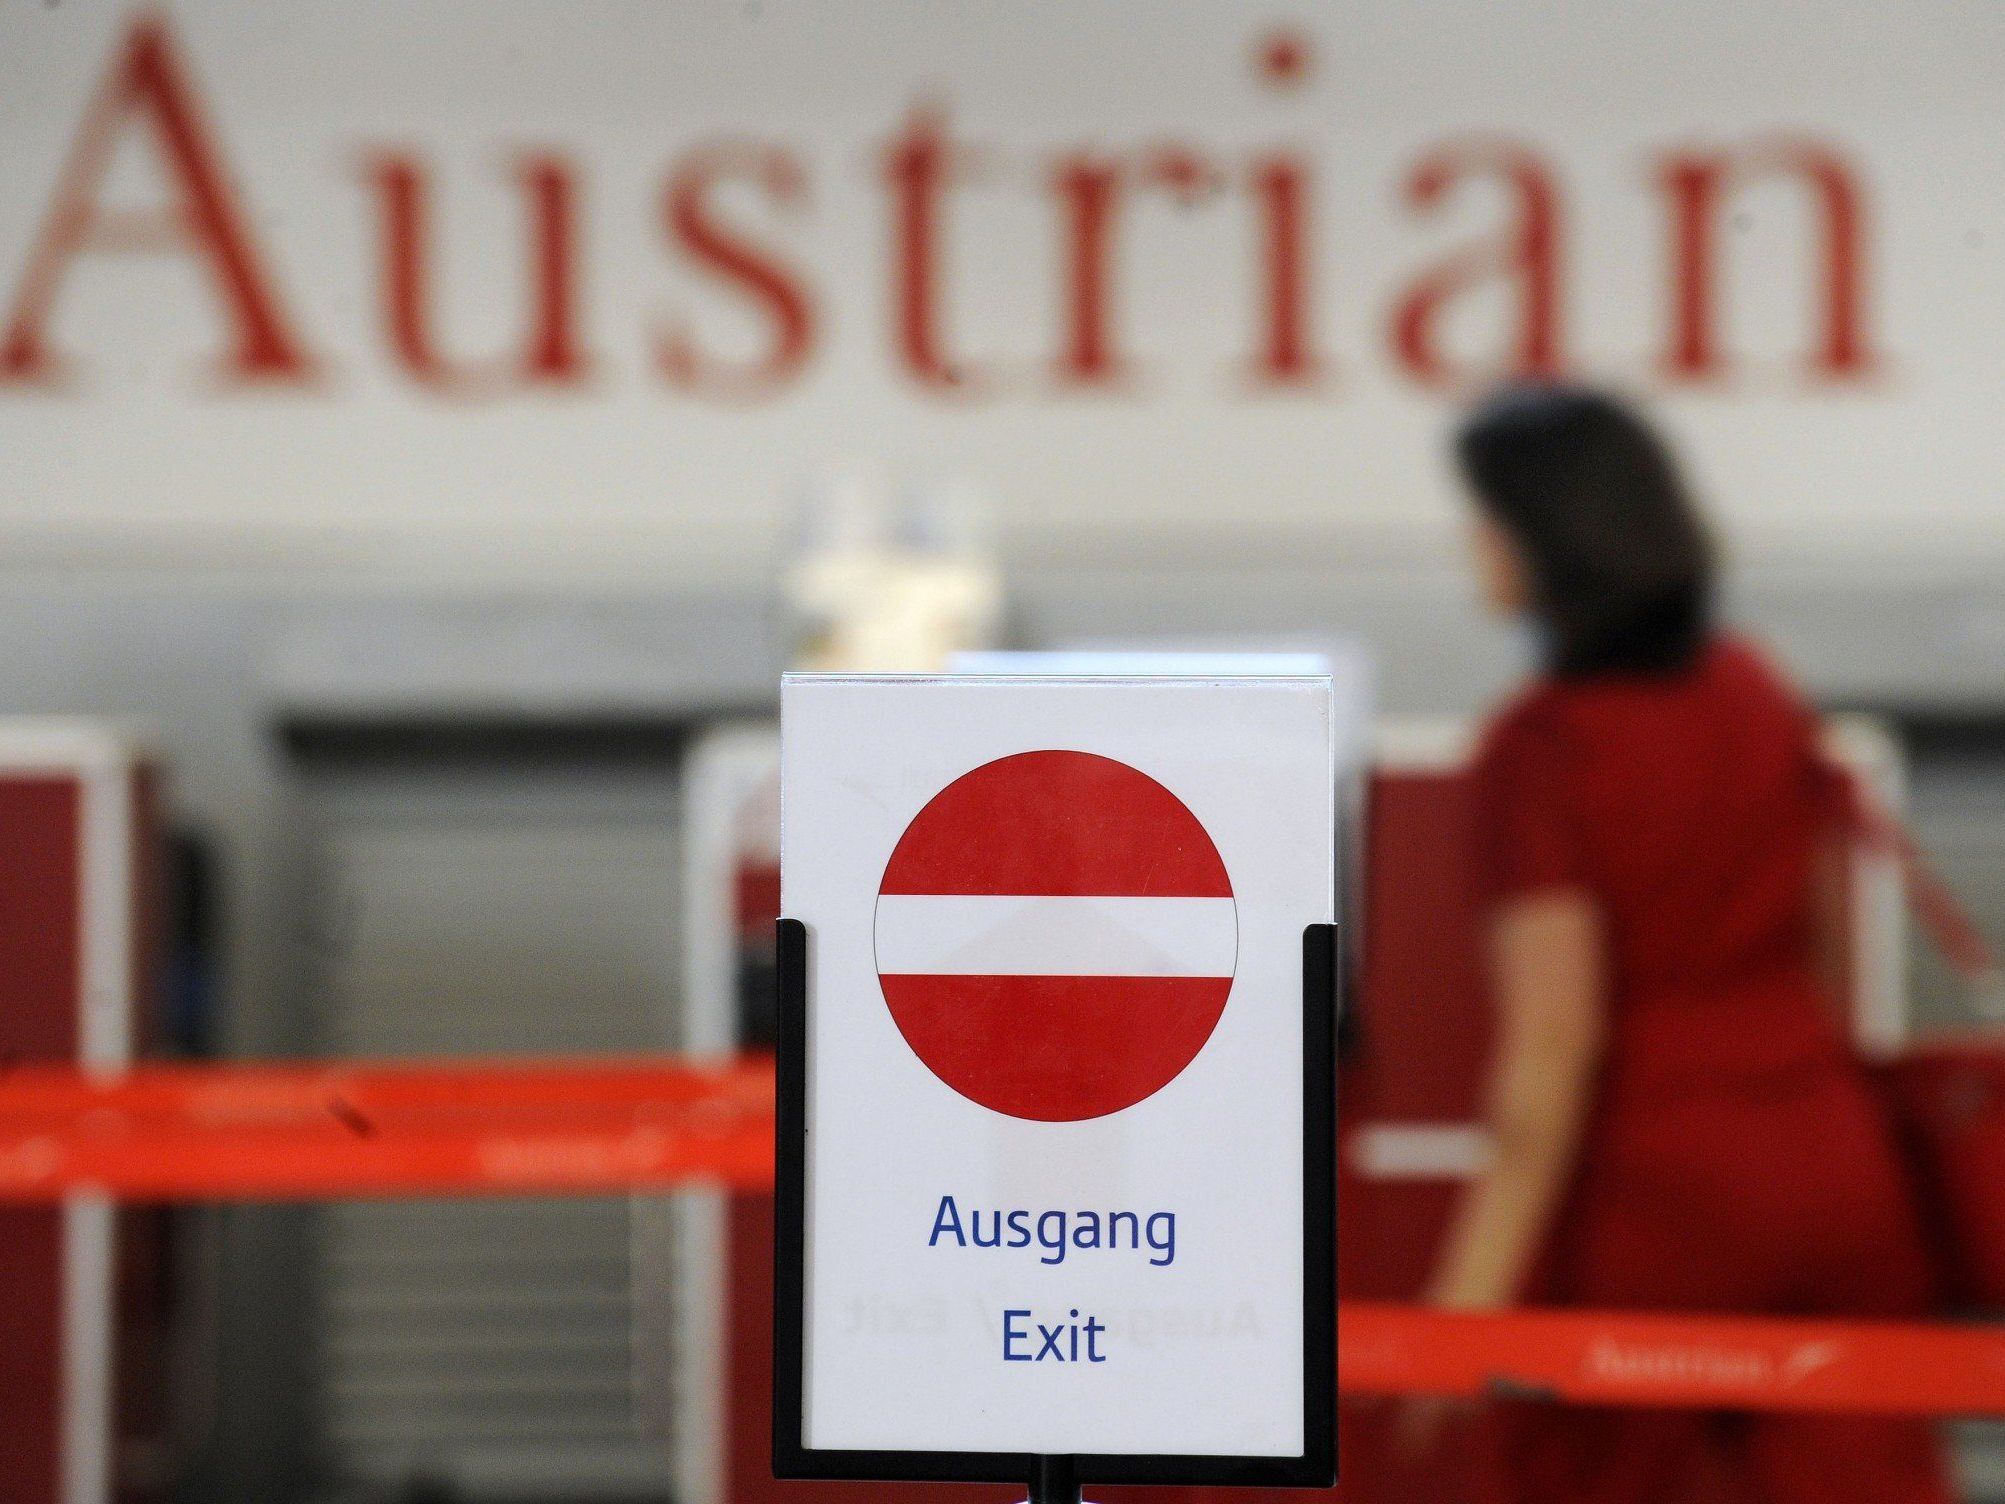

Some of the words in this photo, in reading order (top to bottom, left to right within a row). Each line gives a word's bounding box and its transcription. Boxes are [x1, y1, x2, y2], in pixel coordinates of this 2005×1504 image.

[0, 14, 1888, 394] Austrian
[928, 1195, 1176, 1267] Ausgang
[1003, 1309, 1107, 1363] Exit
